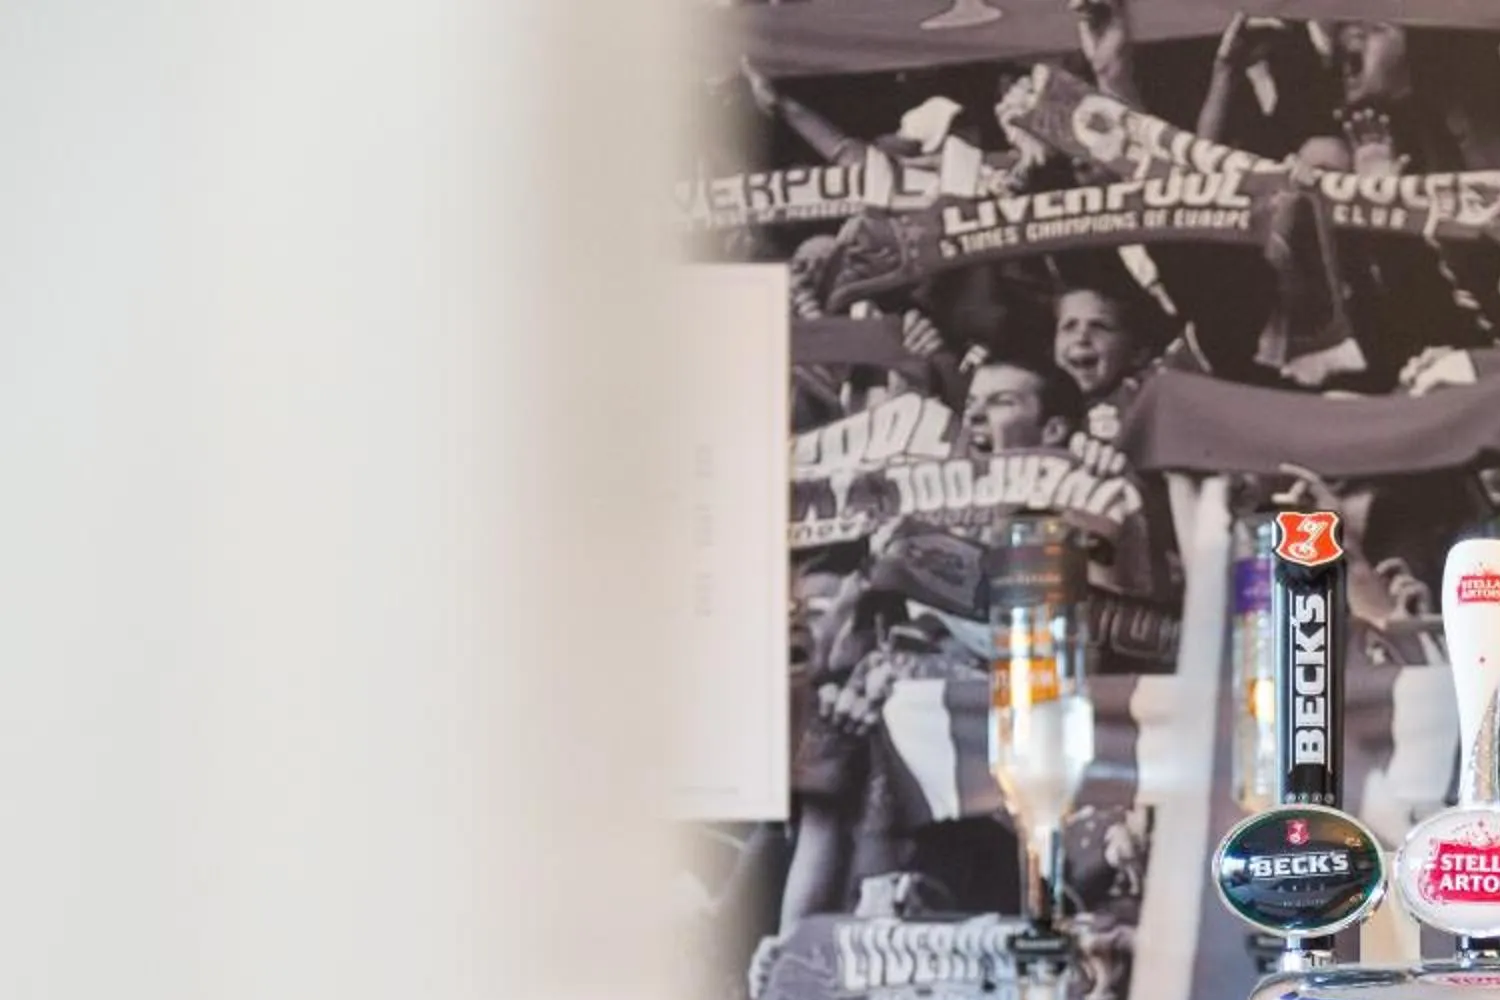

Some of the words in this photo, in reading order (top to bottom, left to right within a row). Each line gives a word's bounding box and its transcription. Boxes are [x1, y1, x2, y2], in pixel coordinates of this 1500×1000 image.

[1026, 210, 1137, 243] CHAMPIONS
[1172, 208, 1251, 230] EUROPE
[1291, 593, 1325, 764] BECK'S
[1249, 851, 1350, 878] BECK'S
